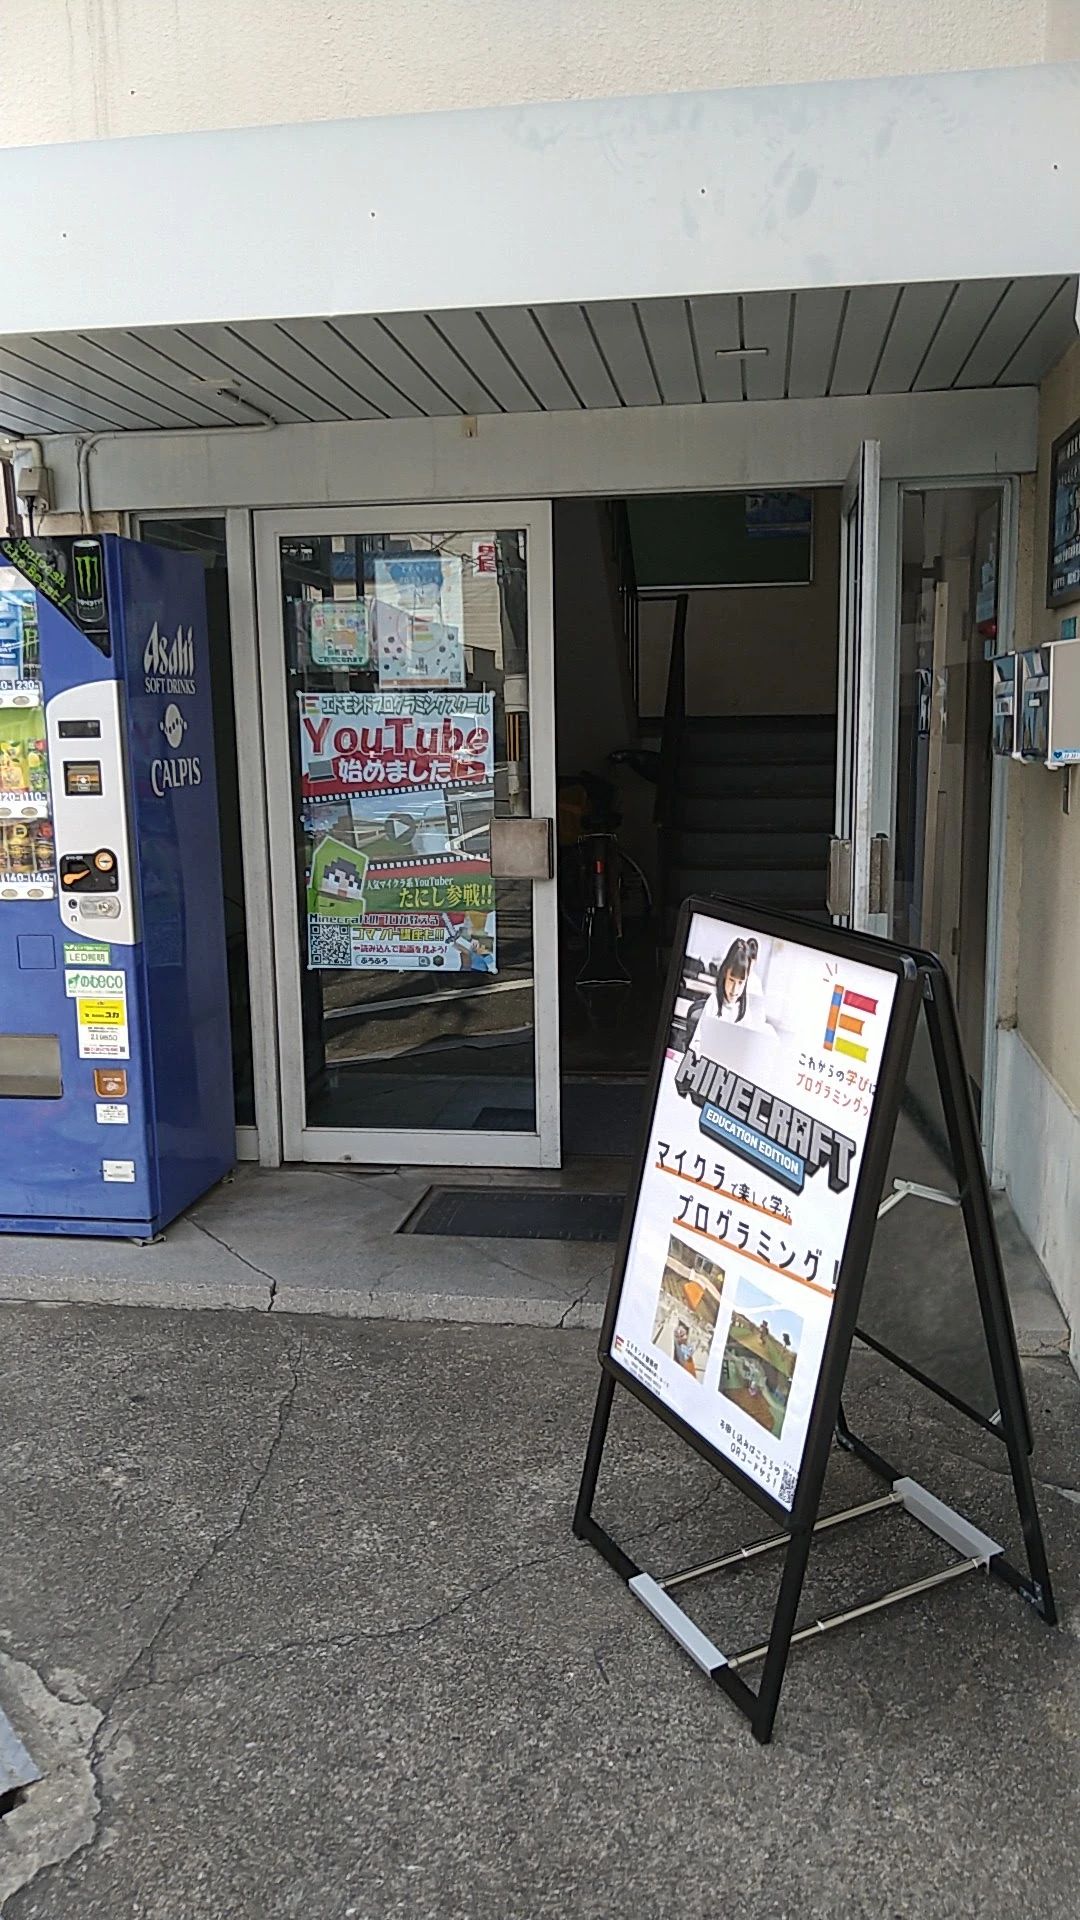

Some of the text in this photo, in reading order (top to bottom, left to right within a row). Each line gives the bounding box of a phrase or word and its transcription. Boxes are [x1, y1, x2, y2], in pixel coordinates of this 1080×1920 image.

[143, 621, 195, 676] Asahi
[145, 676, 196, 695] SOFT DRINKS
[302, 717, 490, 757] YouTube
[151, 757, 202, 797] CALPIS
[339, 758, 452, 784] 始めました
[414, 876, 453, 887] YouTuber
[674, 1048, 857, 1195] MINECRAFT
[705, 1108, 800, 1176] EDUCATION EDITION
